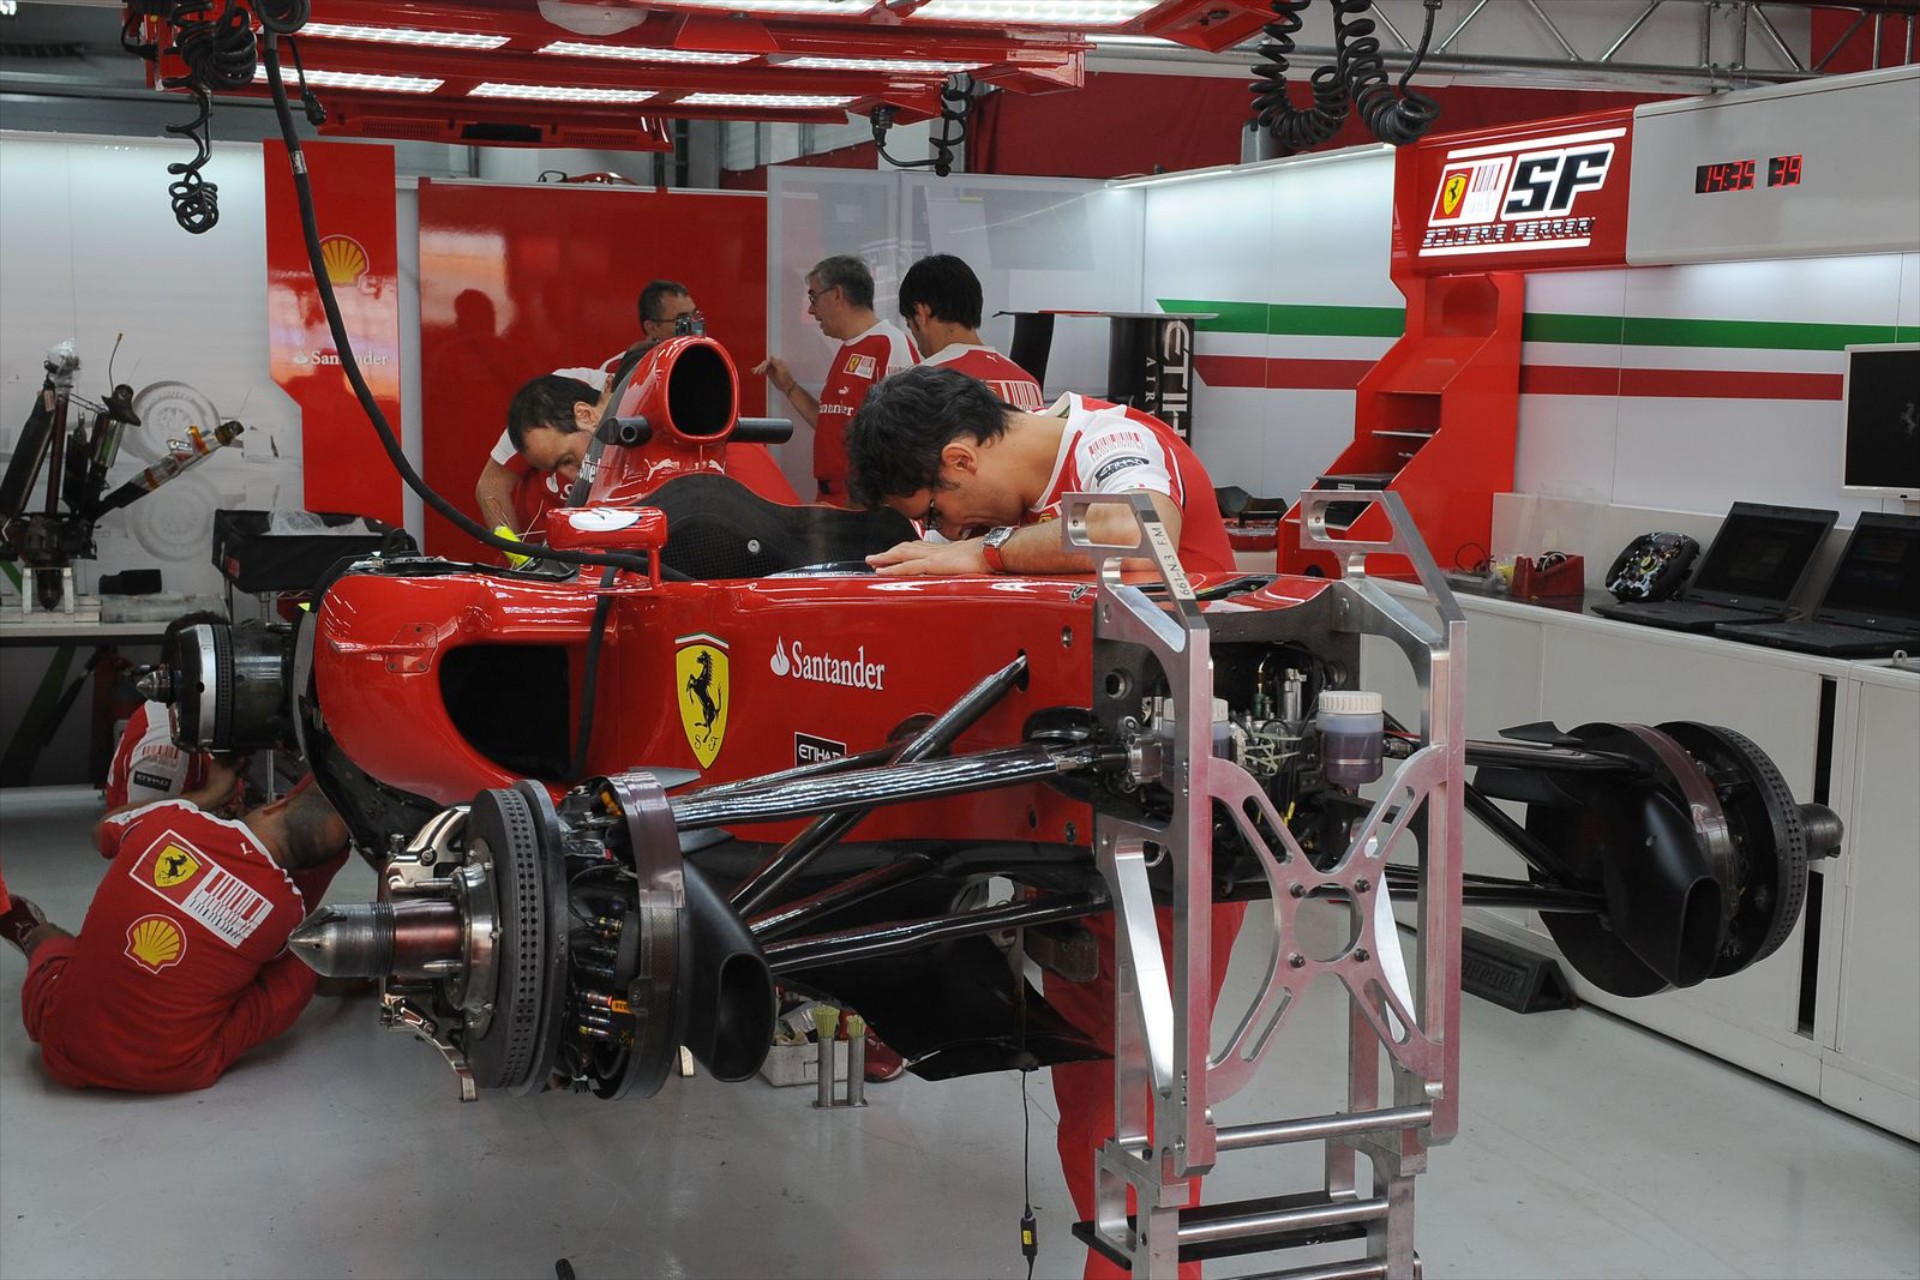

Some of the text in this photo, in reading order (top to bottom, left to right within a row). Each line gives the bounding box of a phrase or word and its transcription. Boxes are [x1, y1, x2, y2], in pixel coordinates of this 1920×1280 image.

[1502, 147, 1612, 216] SF
[1705, 154, 1802, 192] 14:35 39
[1422, 217, 1597, 248] SCUDERIA FERRARI
[311, 349, 387, 366] Sannder
[1162, 320, 1190, 438] ETIH
[791, 640, 886, 691] Santander
